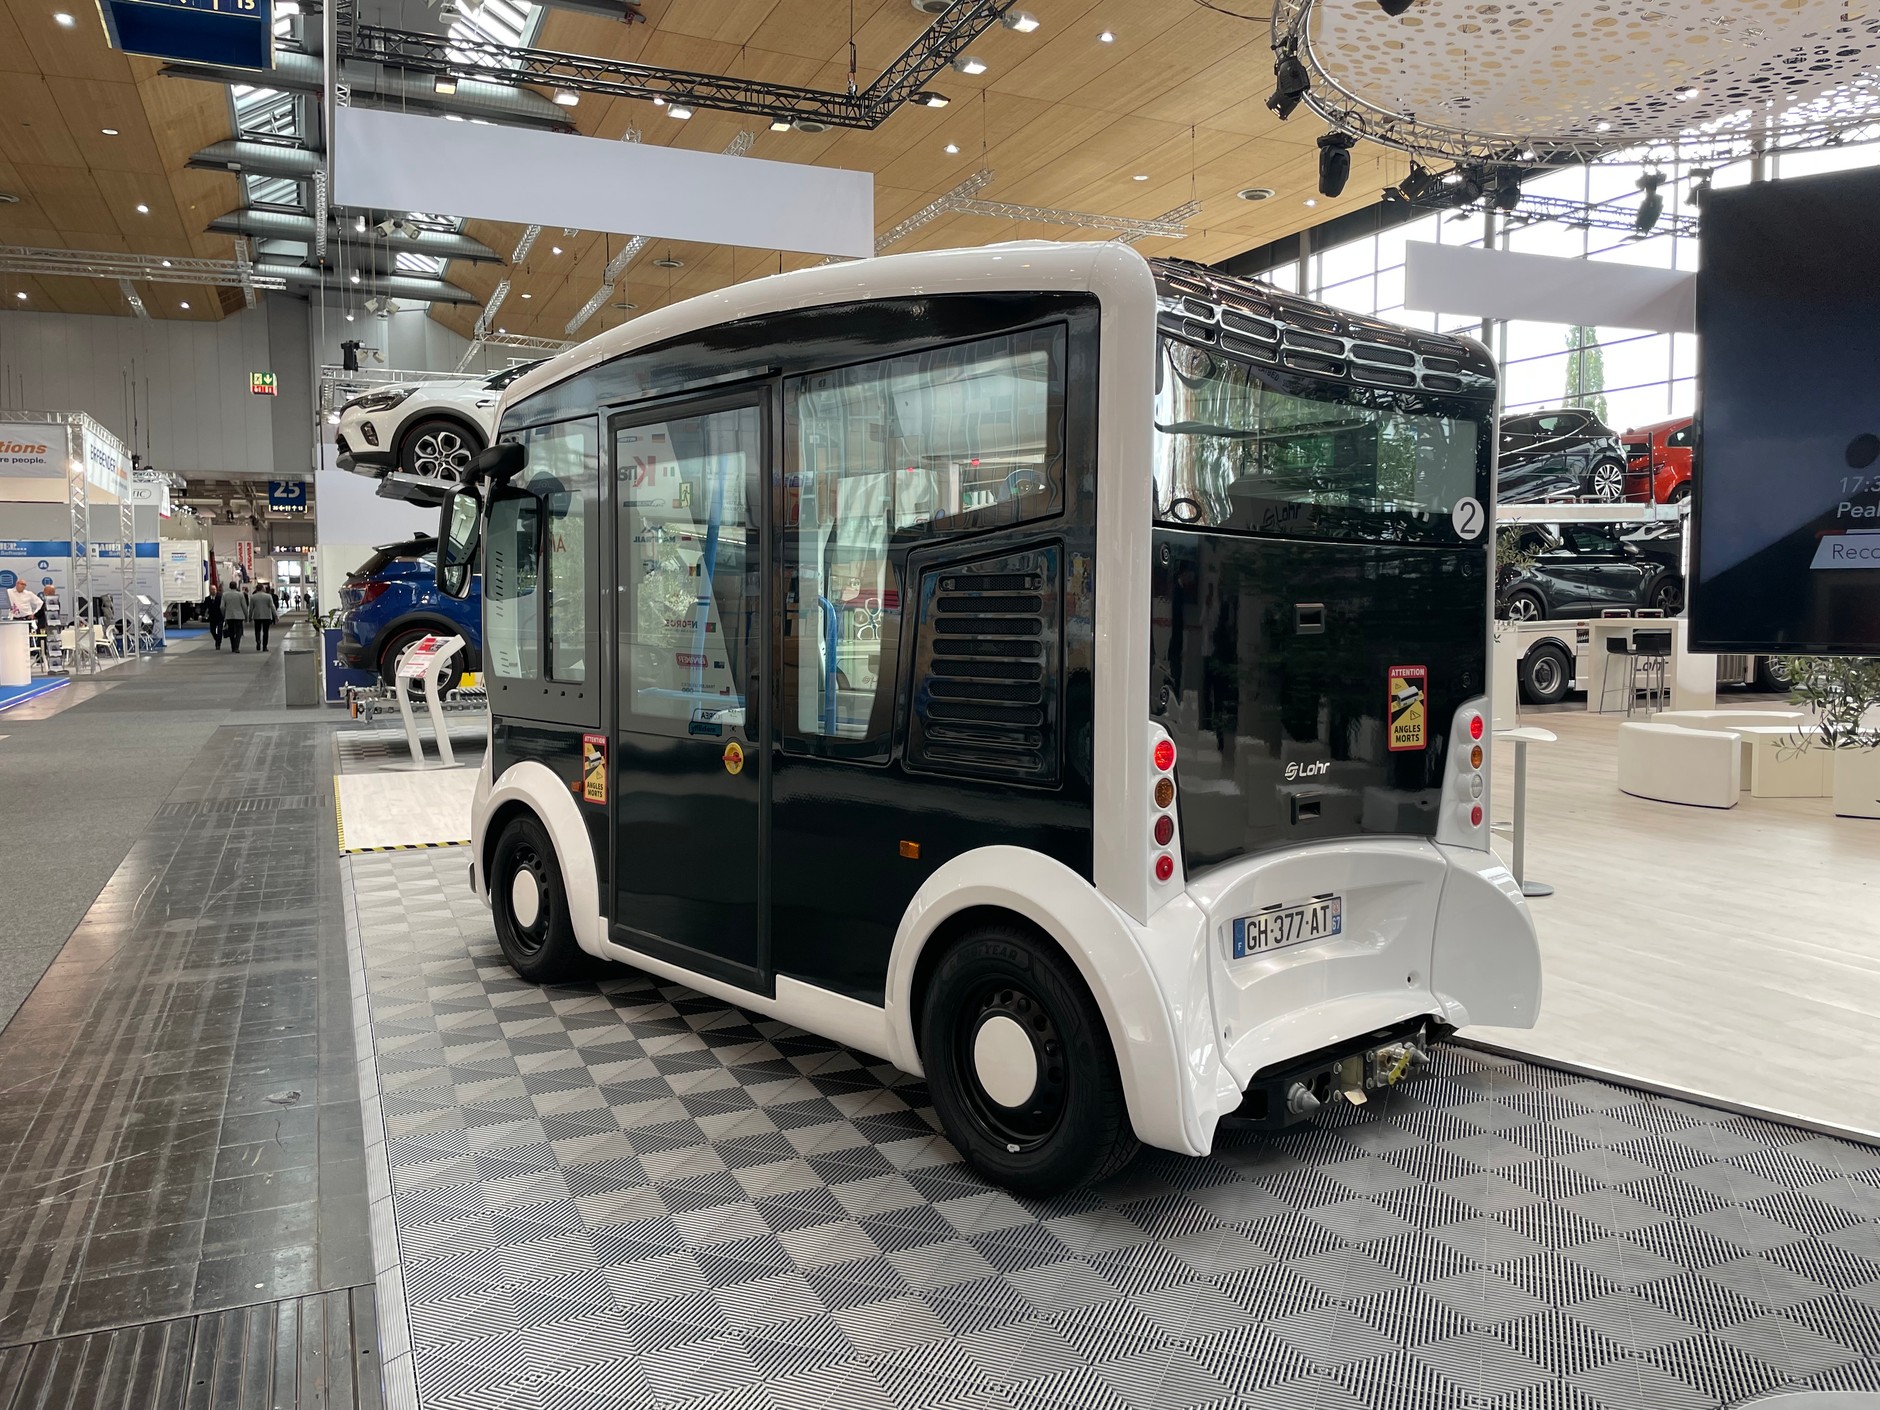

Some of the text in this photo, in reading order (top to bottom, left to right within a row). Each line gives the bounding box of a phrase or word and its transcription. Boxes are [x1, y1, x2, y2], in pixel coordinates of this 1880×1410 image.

[12, 457, 47, 465] people.
[273, 481, 301, 498] 25
[1460, 502, 1477, 534] 2
[1390, 668, 1425, 677] ATTENTION
[1394, 724, 1421, 734] ANGLES
[584, 736, 606, 744] ATTENTION
[1395, 734, 1420, 743] MORTS
[1299, 761, 1331, 777] Lohr
[586, 781, 604, 790] ANGLES
[587, 788, 603, 798] MORTS
[1237, 942, 1243, 951] F
